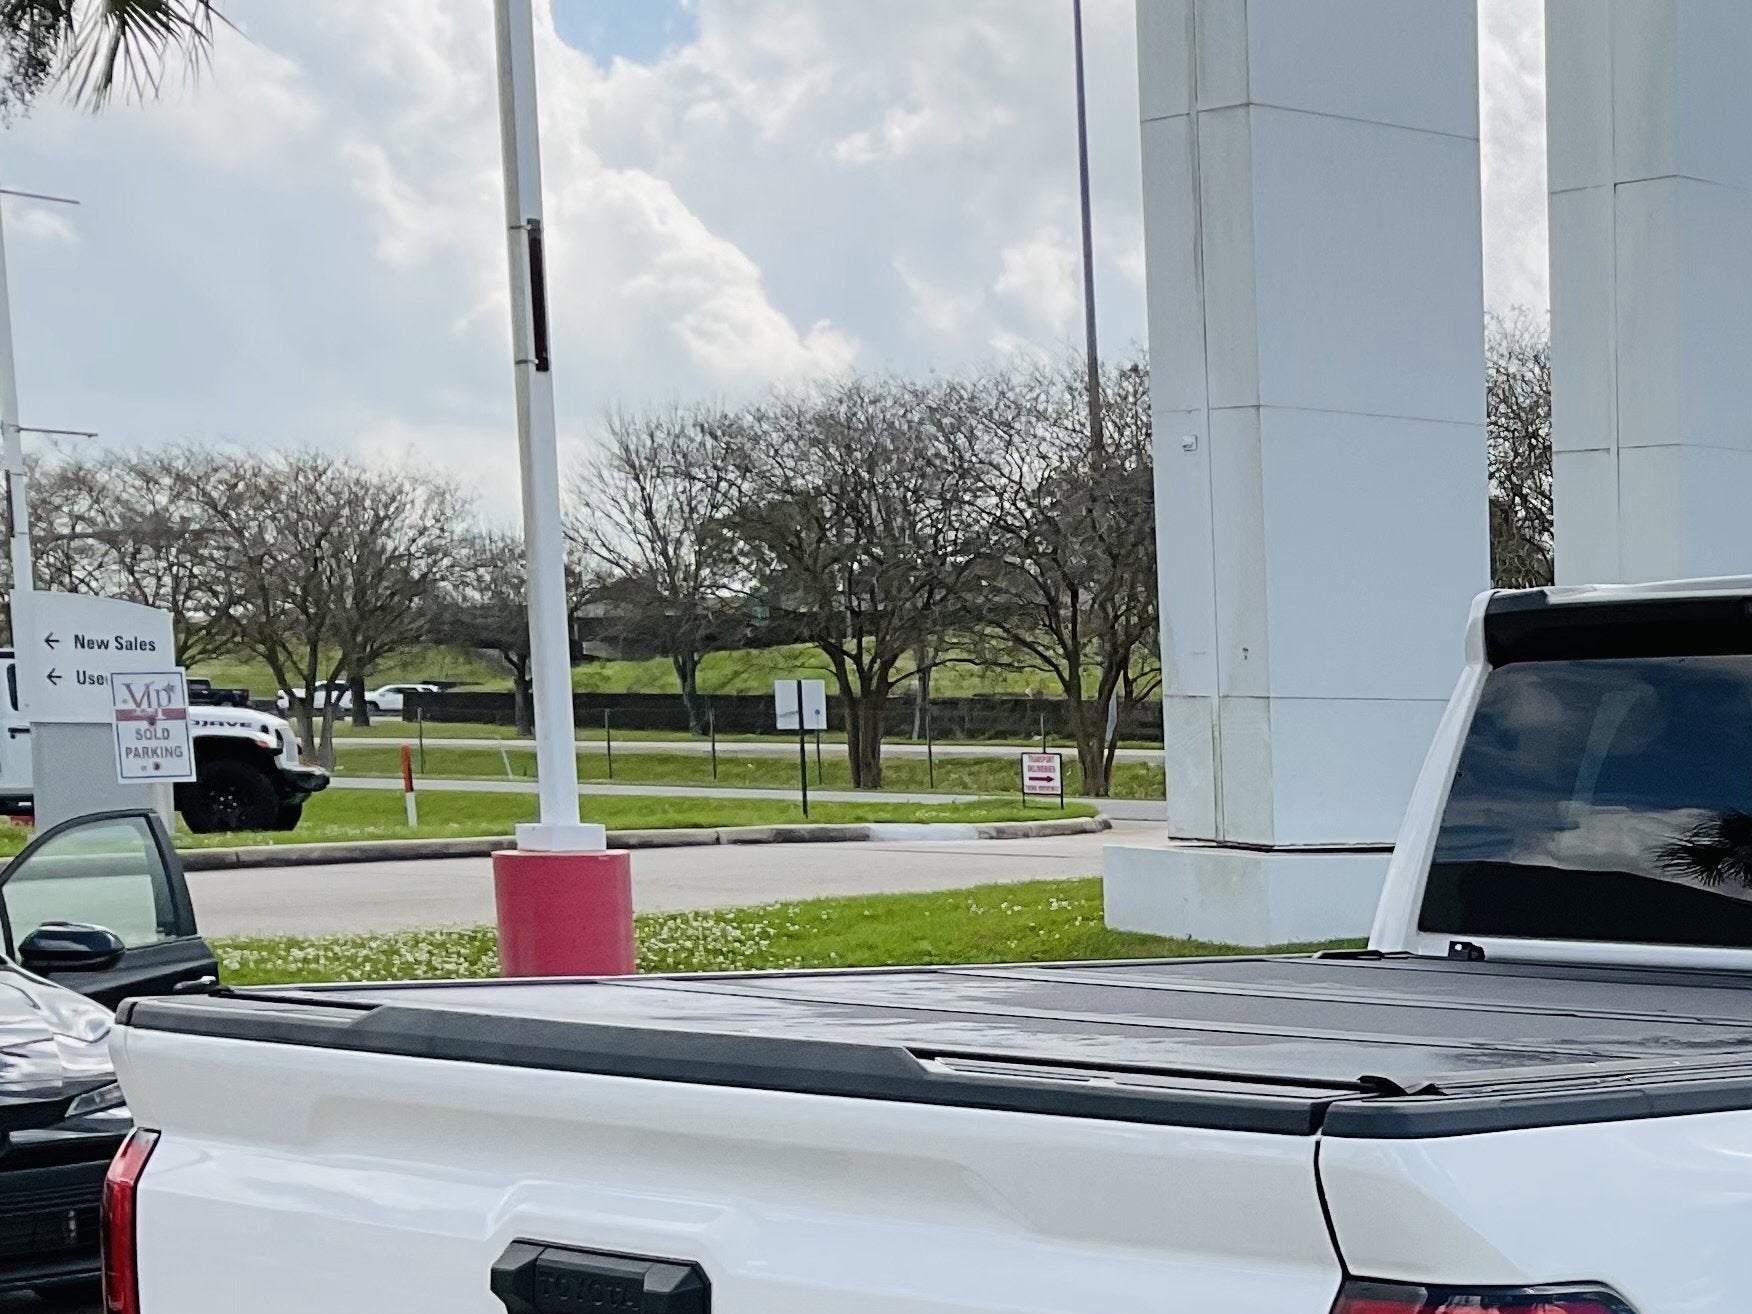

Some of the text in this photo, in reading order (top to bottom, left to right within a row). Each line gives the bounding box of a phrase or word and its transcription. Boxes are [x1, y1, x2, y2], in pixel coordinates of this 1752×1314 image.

[74, 634, 156, 652] New Sales
[76, 670, 109, 685] Use
[135, 728, 170, 740] SOLD
[125, 746, 183, 759] PARKING
